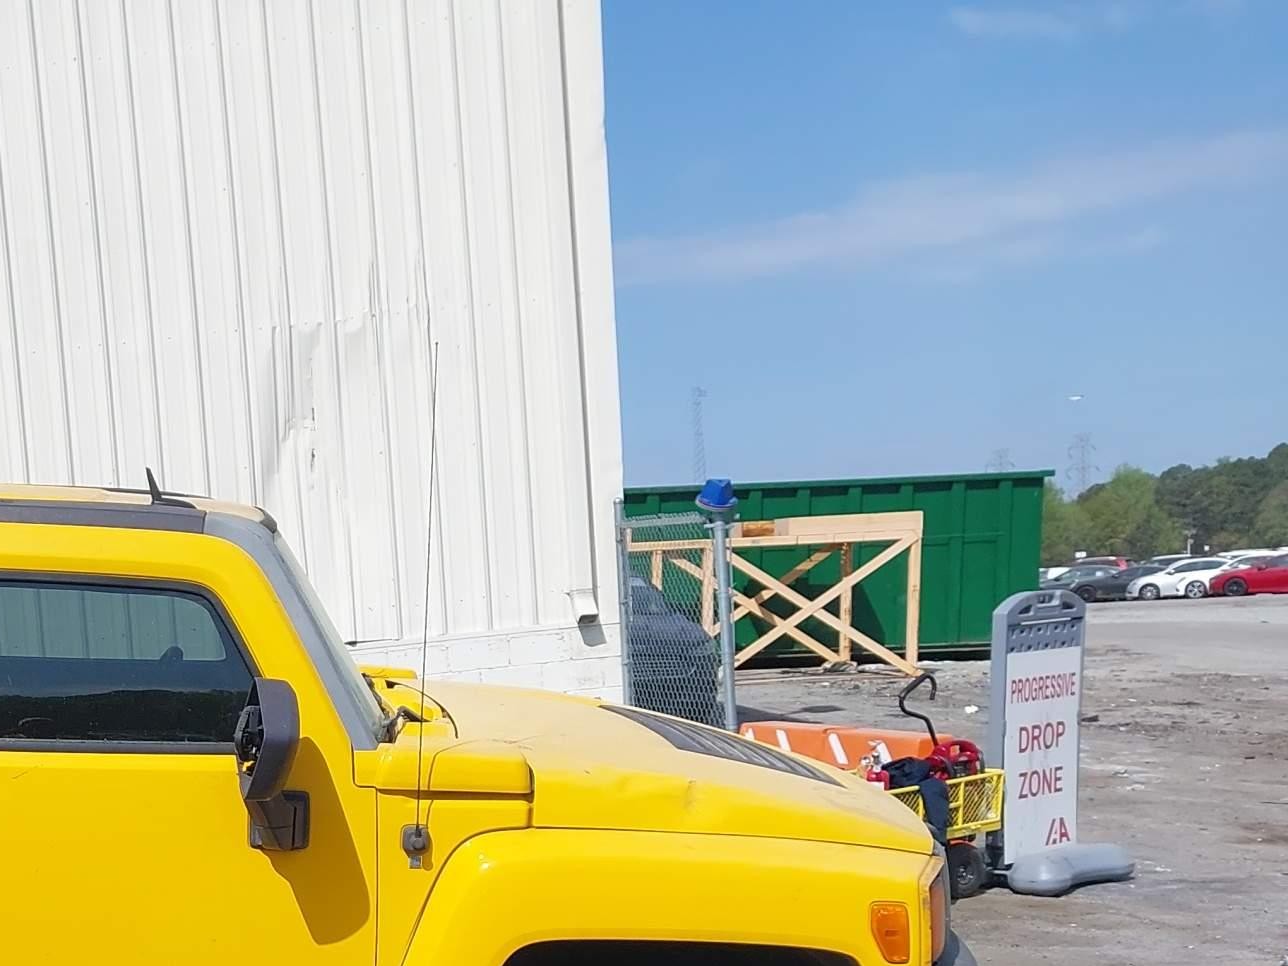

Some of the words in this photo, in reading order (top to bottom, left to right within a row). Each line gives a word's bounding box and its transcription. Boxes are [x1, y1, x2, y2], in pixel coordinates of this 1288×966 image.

[1011, 672, 1076, 704] PROGRESSIVE
[1018, 720, 1066, 753] DROP
[1018, 766, 1063, 799] ZONE
